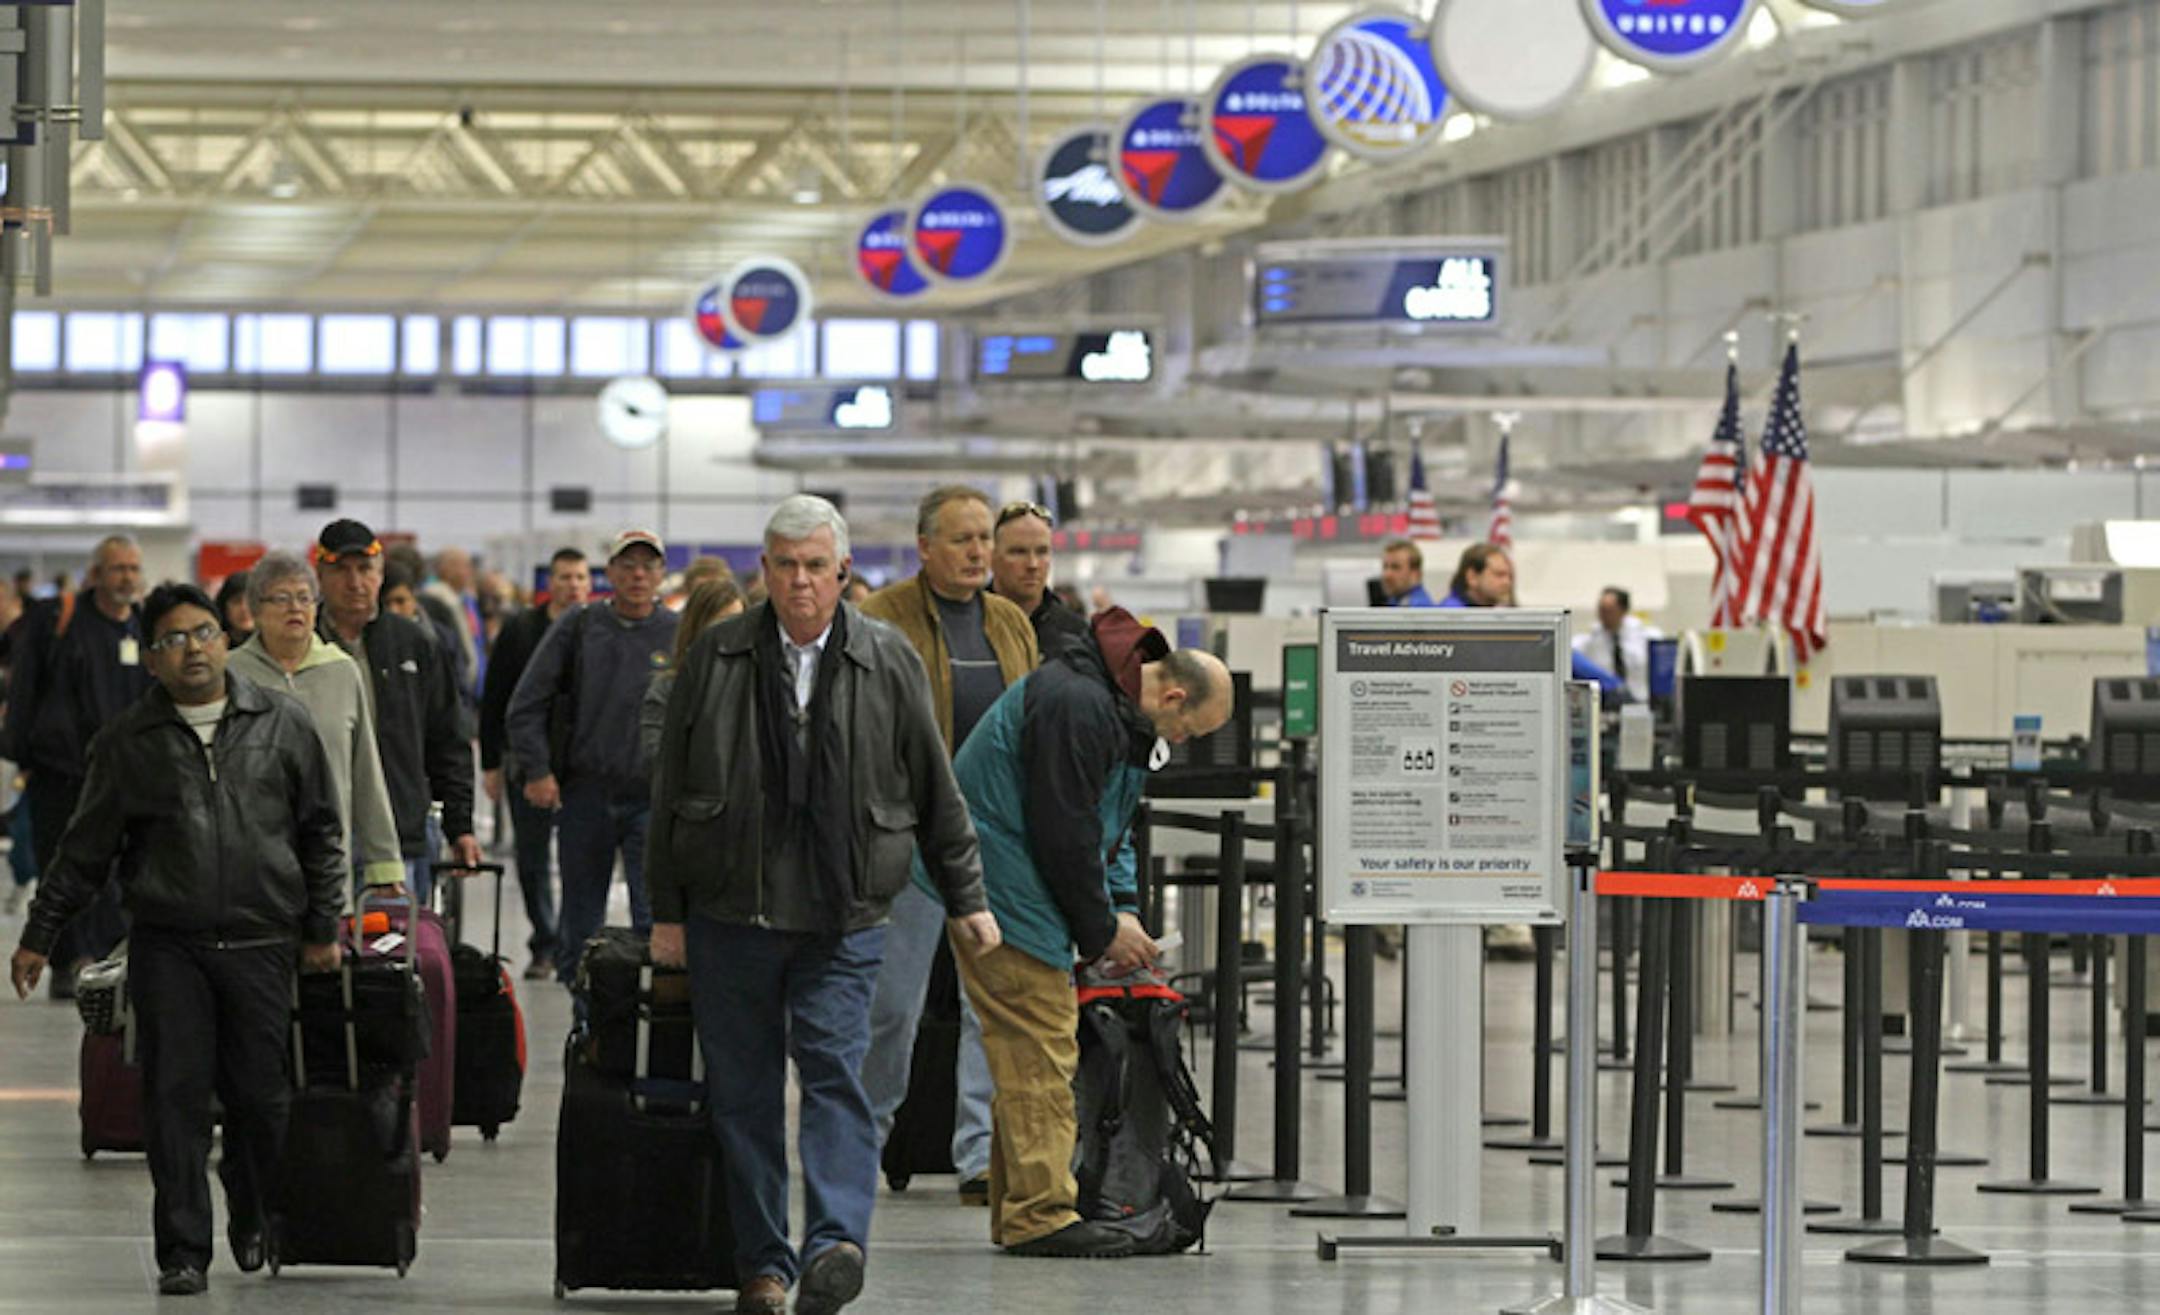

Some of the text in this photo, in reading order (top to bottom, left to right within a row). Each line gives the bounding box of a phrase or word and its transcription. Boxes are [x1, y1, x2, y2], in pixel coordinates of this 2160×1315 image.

[1617, 13, 1726, 35] UNITED
[1348, 641, 1455, 658] Travel Advisory
[1360, 857, 1531, 872] Your safety is our priority
